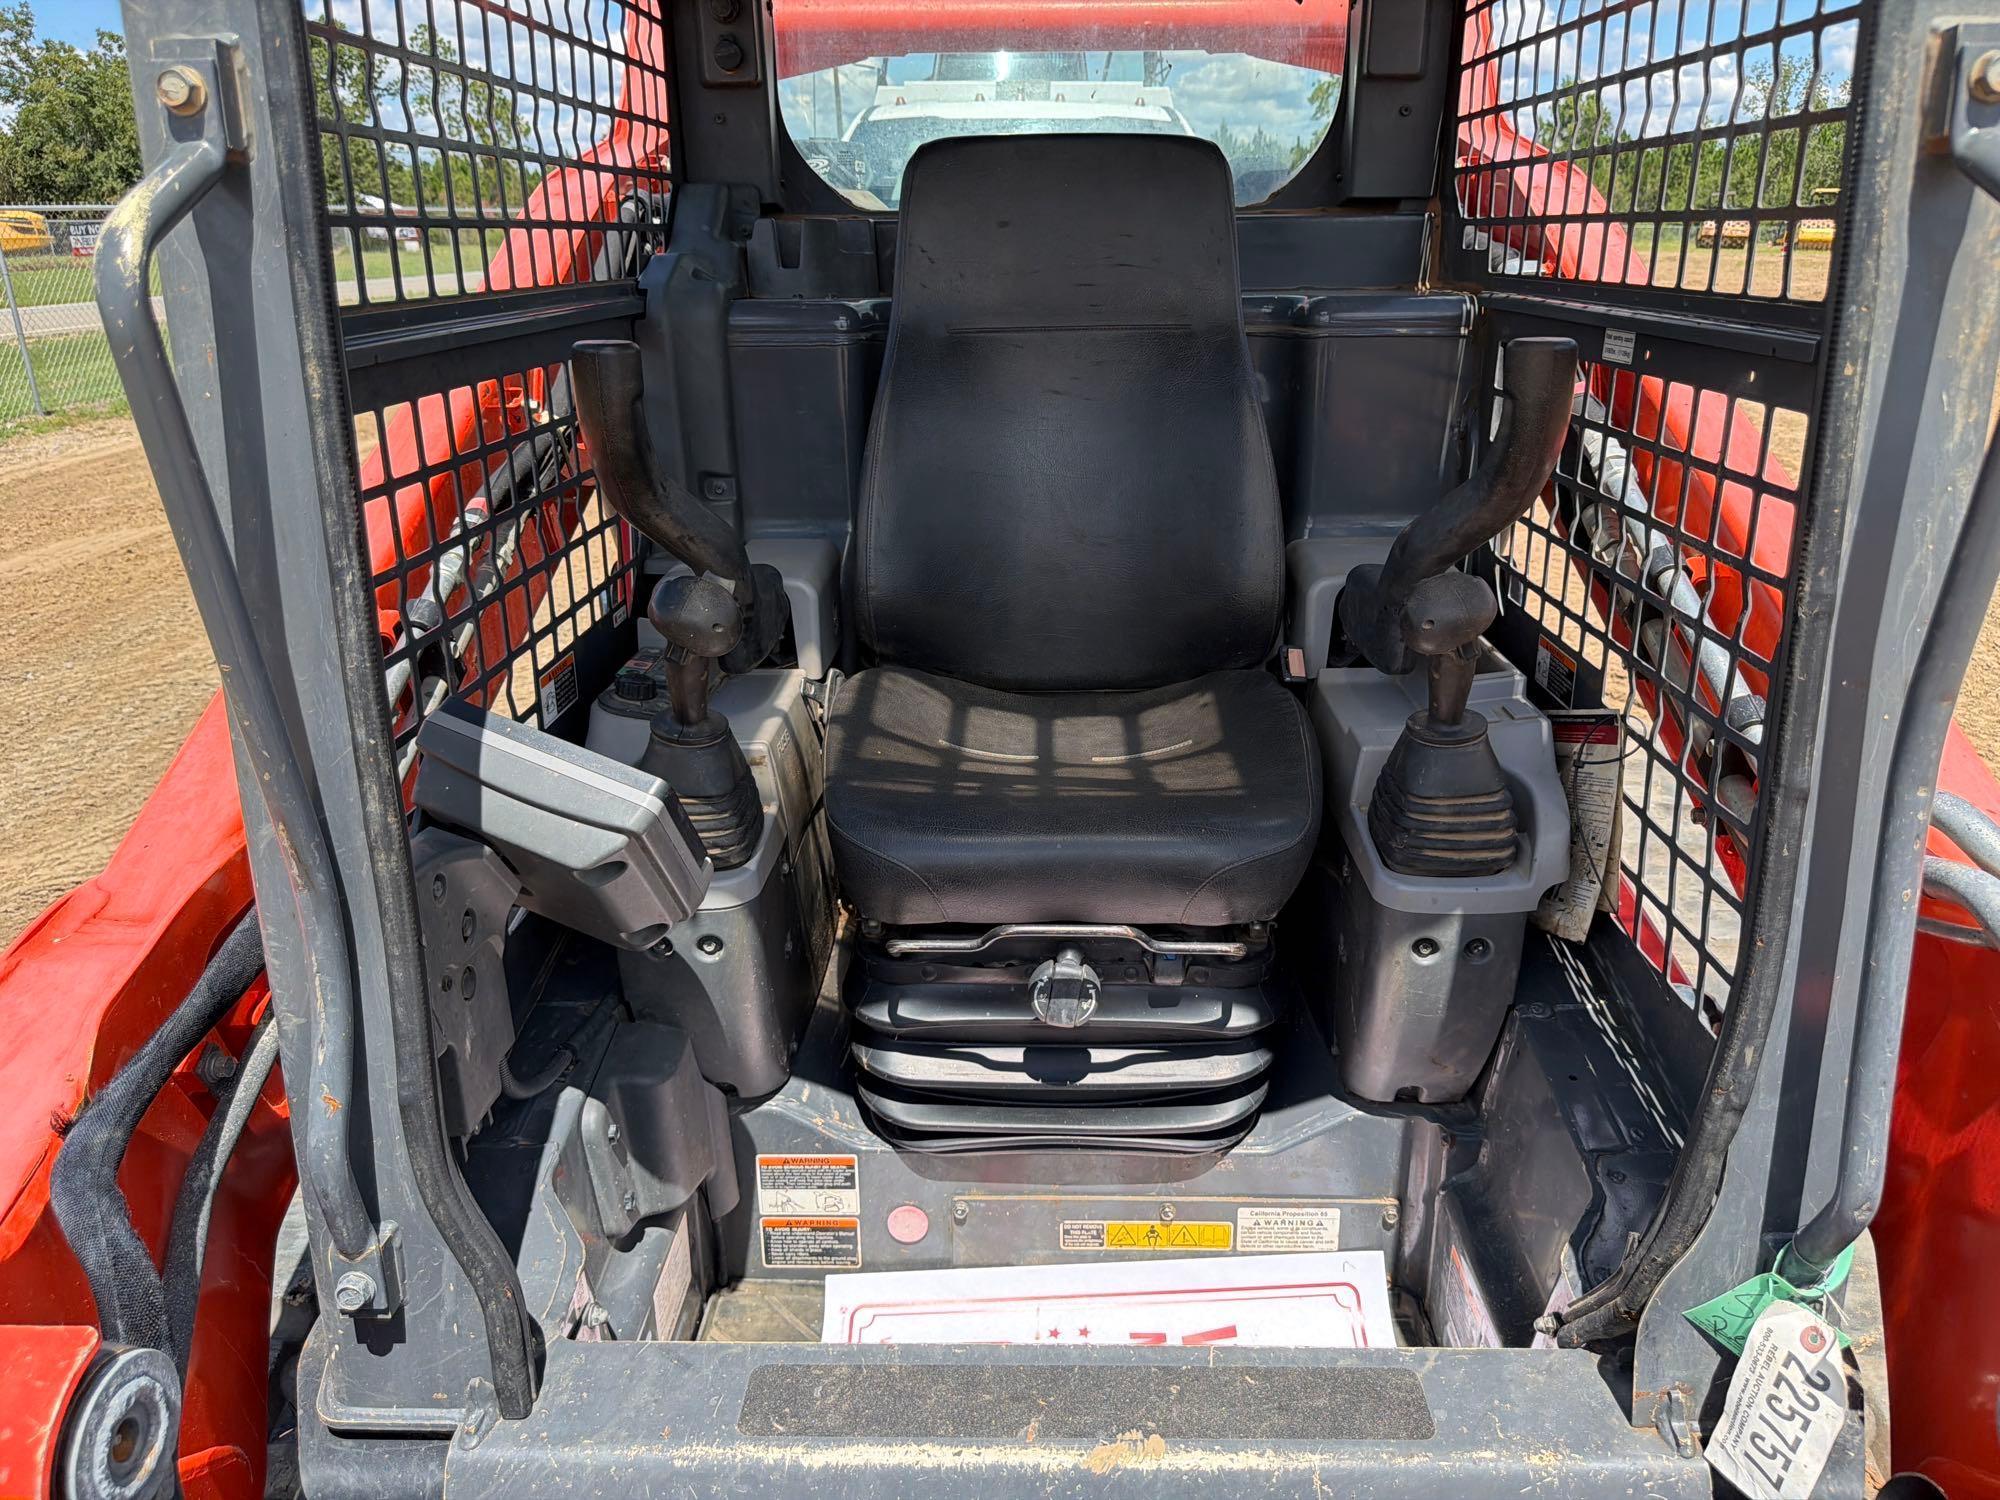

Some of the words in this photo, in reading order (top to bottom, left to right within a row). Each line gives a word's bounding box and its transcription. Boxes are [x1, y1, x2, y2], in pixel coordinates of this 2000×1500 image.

[70, 225, 86, 235] BUY
[790, 1157, 831, 1165] WARNING
[1760, 1343, 1779, 1371] REBEL
[1747, 1372, 1766, 1410] AUCTION
[1731, 1410, 1750, 1451] COMPANY
[1743, 1350, 1831, 1492] 225757
